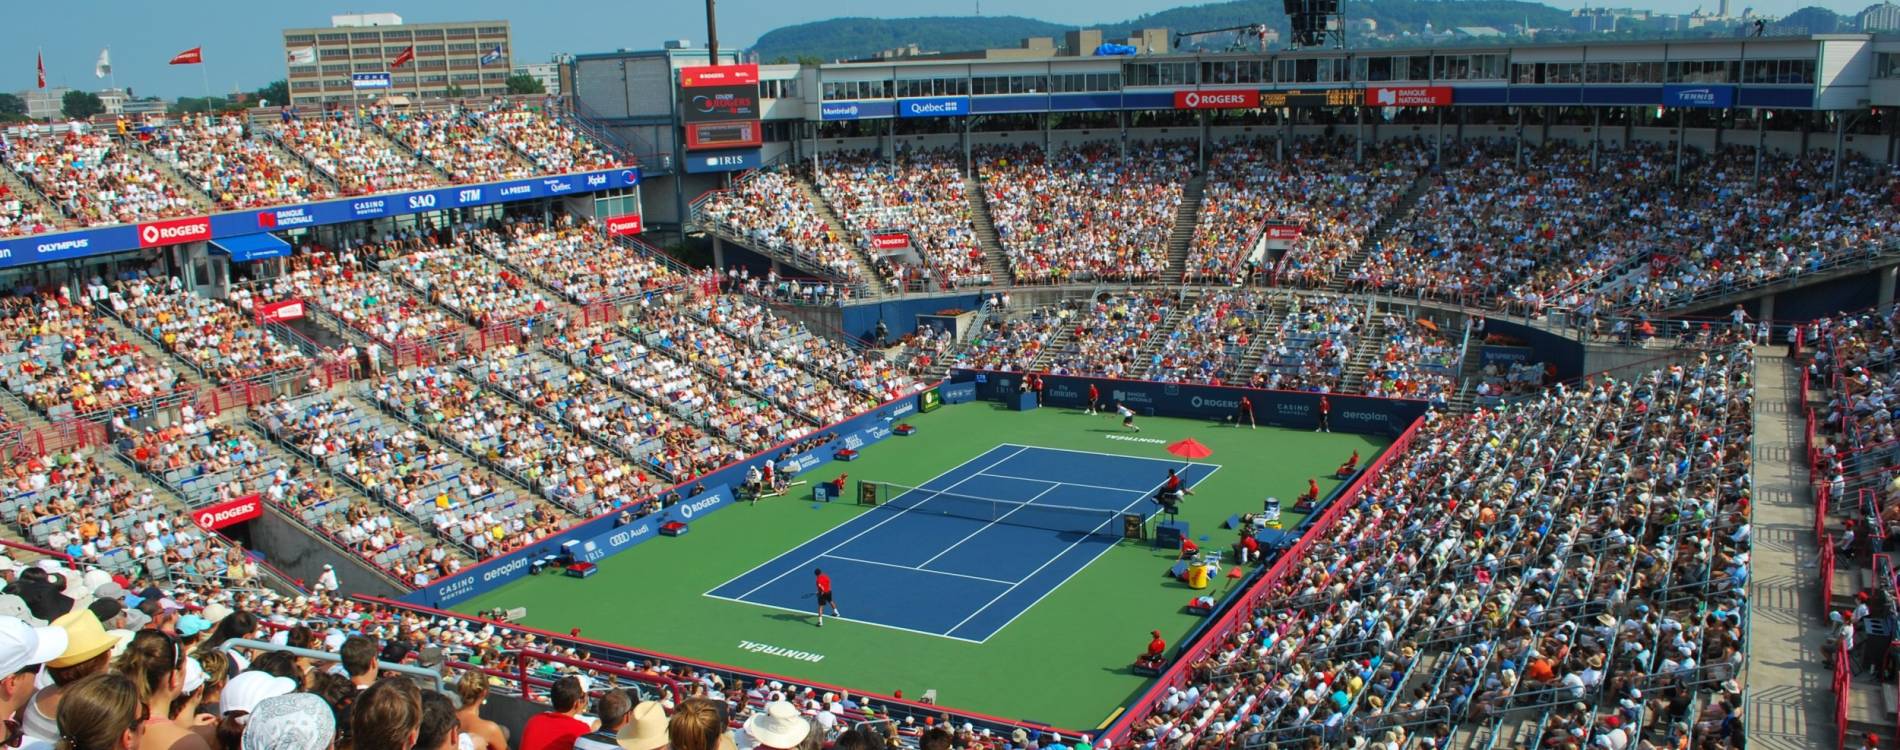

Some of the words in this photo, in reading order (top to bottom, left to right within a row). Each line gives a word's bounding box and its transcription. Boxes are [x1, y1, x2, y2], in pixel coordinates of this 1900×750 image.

[1398, 89, 1427, 97] BANQUE
[1201, 95, 1245, 104] ROGERS
[823, 106, 850, 115] Montréal
[911, 103, 945, 113] Québec
[719, 155, 743, 166] IRIS
[460, 189, 480, 203] STM
[500, 187, 510, 196] LA
[509, 185, 531, 194] PRESSE
[354, 200, 384, 211] CASINO
[409, 194, 436, 209] SAQ
[276, 208, 304, 218] BANQUE
[277, 214, 313, 226] NATIONALE
[617, 221, 638, 231] ROGERS
[160, 223, 208, 239] ROGERS
[37, 239, 88, 253] OLYMPUS
[1203, 399, 1239, 409] ROGERS
[1277, 402, 1310, 412] CASINO
[1343, 411, 1388, 423] aeroplan
[692, 494, 720, 512] ROGERS
[215, 503, 256, 522] ROGERS
[630, 523, 649, 539] Audi
[585, 548, 605, 563] IRIS
[484, 557, 528, 581] aeroplan
[440, 576, 475, 596] CASINO
[738, 640, 825, 662] MONTRÉAL
